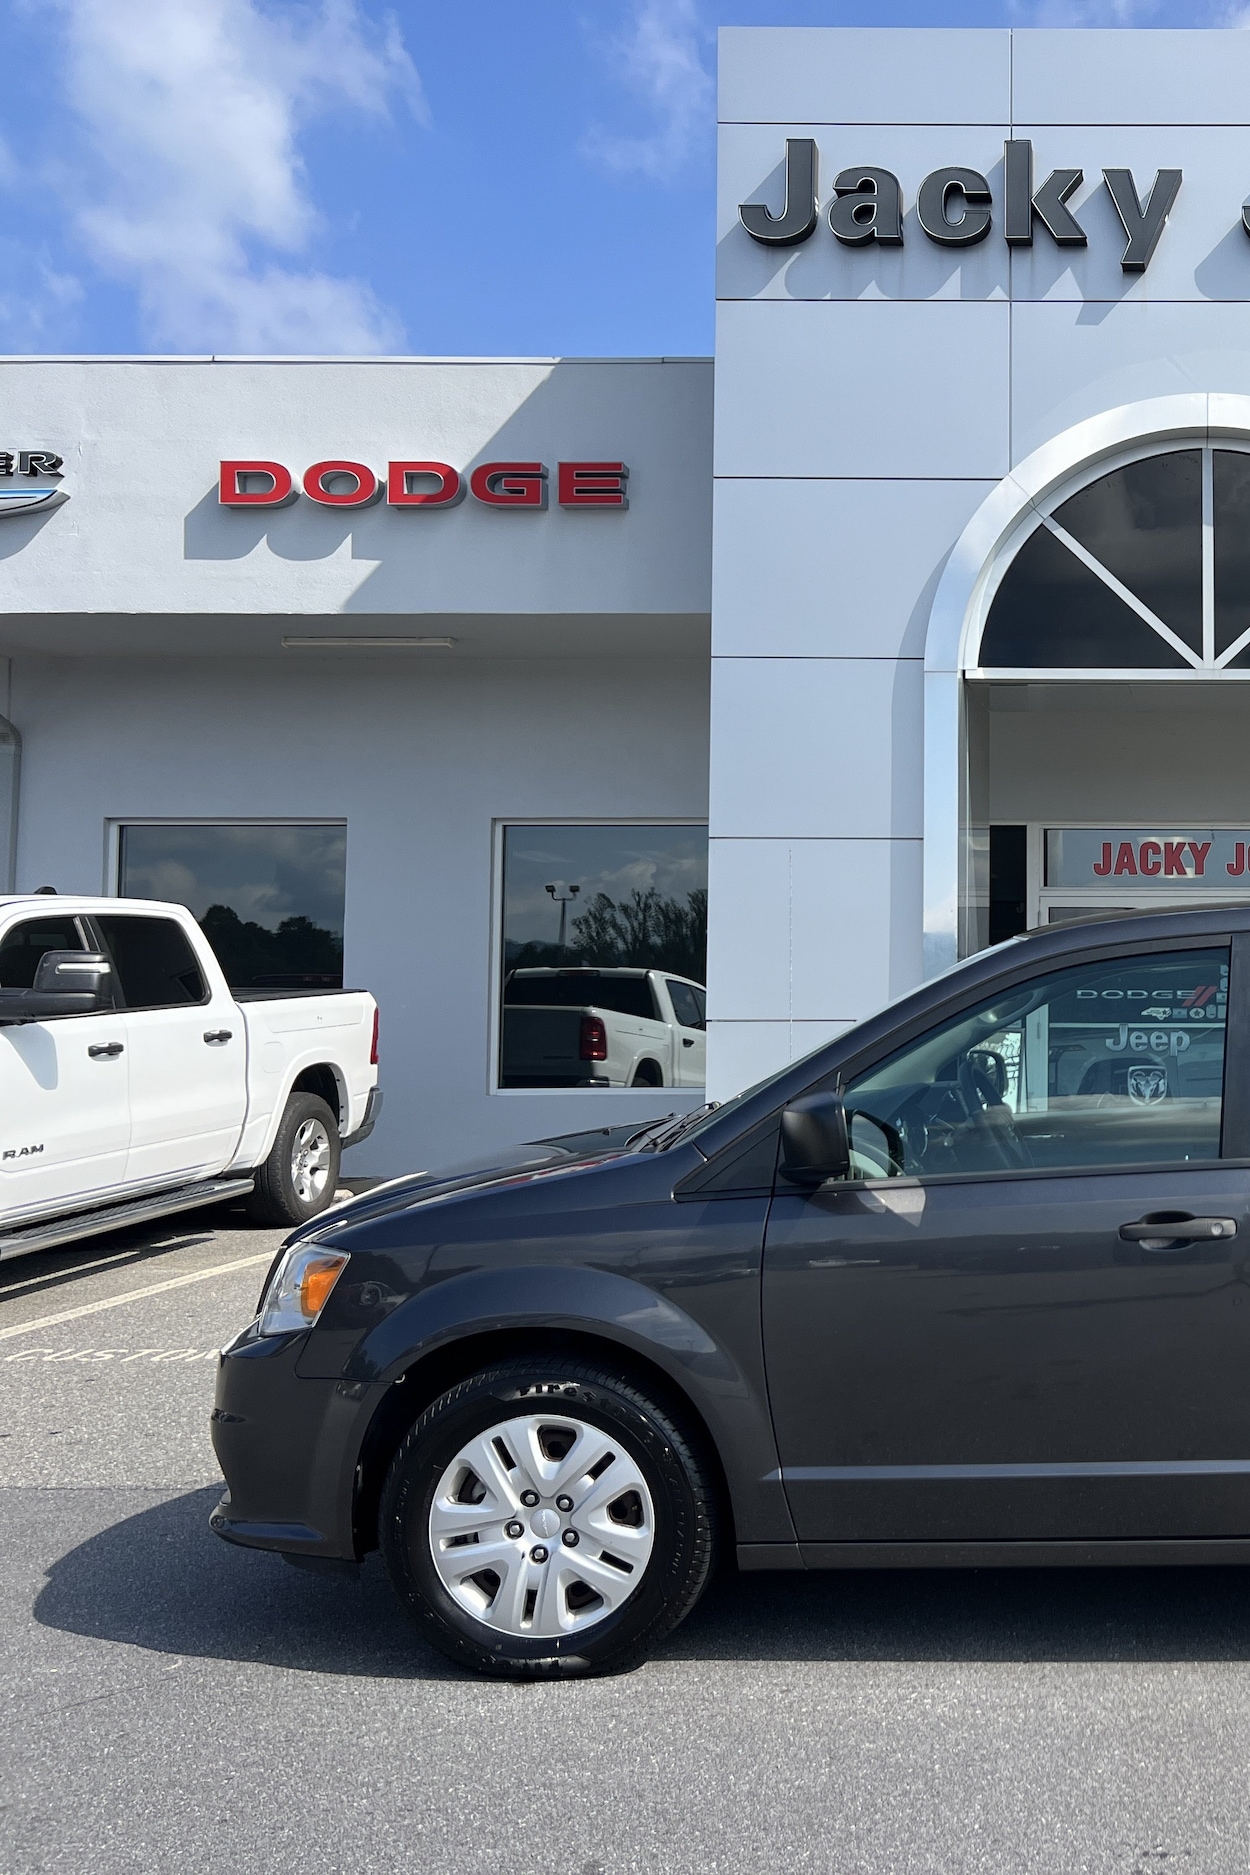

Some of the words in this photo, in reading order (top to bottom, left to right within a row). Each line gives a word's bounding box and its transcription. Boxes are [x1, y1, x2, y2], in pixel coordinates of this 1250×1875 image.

[737, 137, 1182, 273] Jacky
[0, 450, 65, 478] R
[218, 460, 630, 510] DODGE
[1093, 841, 1212, 877] JACKY
[1076, 989, 1196, 999] DODGE
[1105, 1023, 1190, 1057] Jeep
[3, 1144, 44, 1160] RAM
